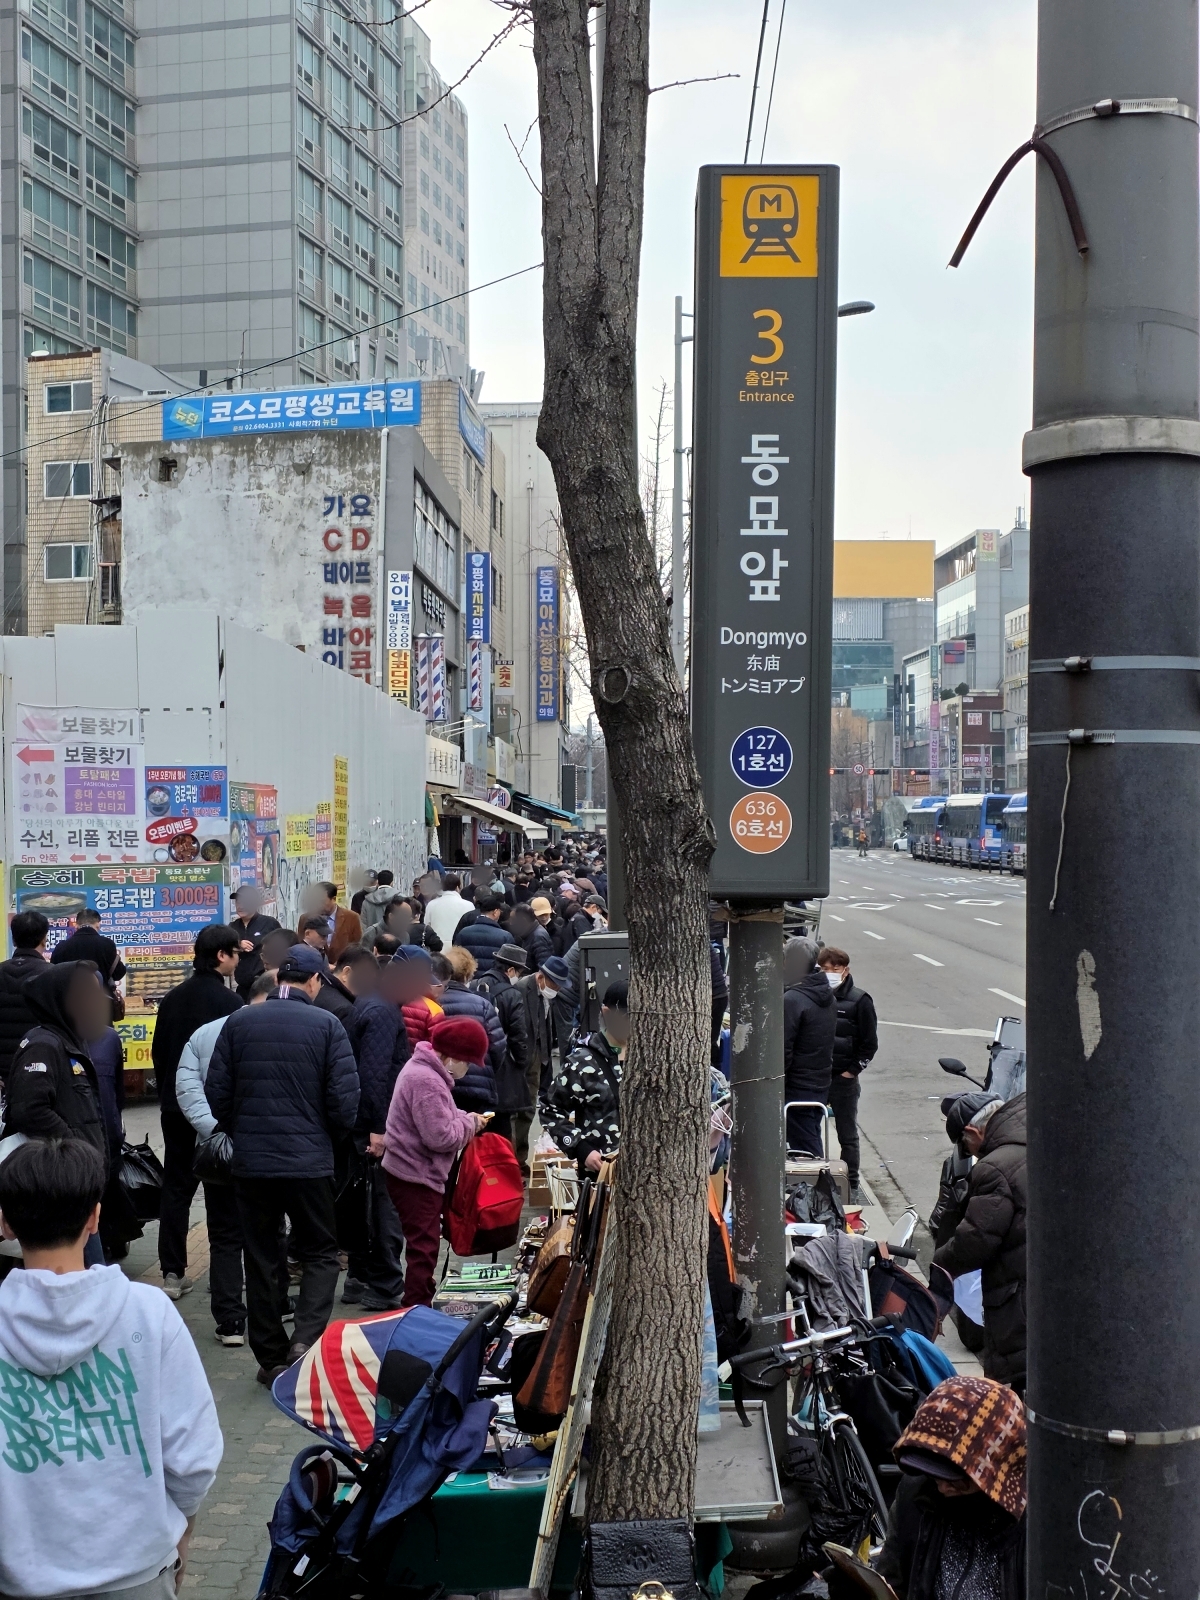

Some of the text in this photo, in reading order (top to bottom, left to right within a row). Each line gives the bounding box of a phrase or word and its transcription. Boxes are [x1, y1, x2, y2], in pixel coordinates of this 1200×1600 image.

[760, 194, 782, 213] M
[750, 309, 784, 365] 3
[745, 370, 789, 387] 출입구
[209, 388, 414, 423] 코스모평생교육원
[739, 390, 795, 402] Entrance
[740, 434, 790, 601] 동묘앞
[322, 561, 372, 585] 테이프
[323, 595, 372, 619] 녹음
[391, 585, 411, 612] 이발
[720, 626, 808, 650] Dongmyo
[746, 654, 781, 671] 东庙
[721, 676, 806, 694] トンミョアプ
[539, 708, 554, 717] 의원
[61, 717, 134, 736] 보물찾기
[747, 735, 777, 750] 127
[64, 746, 131, 765] 보물찾기
[738, 753, 785, 772] 1호선
[79, 769, 120, 781] 토탈패션
[97, 789, 126, 799] 스타일
[74, 802, 126, 812] 강남 빈티지
[745, 800, 777, 816] 636
[148, 818, 194, 840] 오픈이벤트
[736, 819, 784, 838] 6호선
[20, 829, 140, 849] 수선, 리폼 전문
[21, 853, 59, 863] 5m 안쪽
[22, 869, 85, 887] 송해
[97, 867, 161, 885] 국밥
[94, 885, 220, 910] 경로국밥 3,000원
[0, 1382, 152, 1478] BREATH
